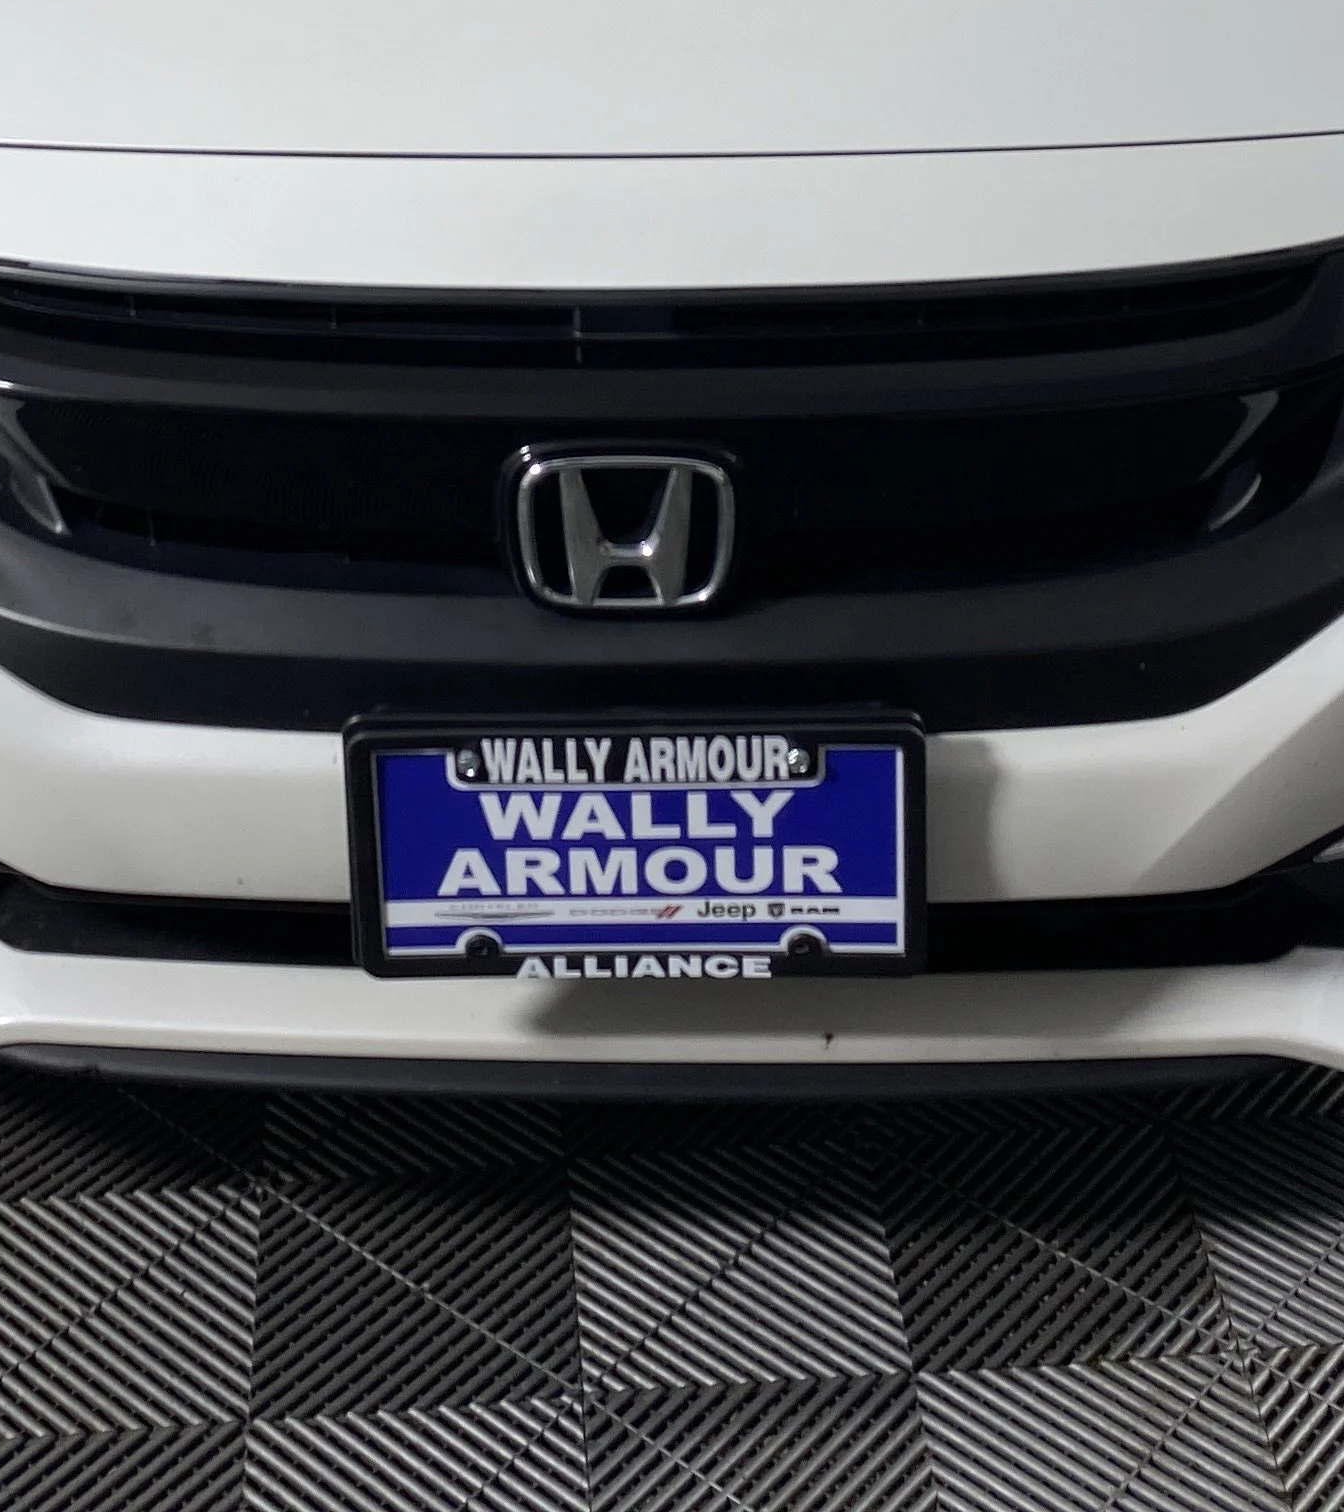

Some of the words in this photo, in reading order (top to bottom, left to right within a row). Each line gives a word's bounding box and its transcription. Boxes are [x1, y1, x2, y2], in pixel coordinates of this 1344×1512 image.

[480, 737, 612, 784] WALLY
[623, 735, 789, 783] ARMOUR
[478, 791, 795, 841] WALLY
[437, 845, 842, 896] ARMOUR
[697, 901, 757, 921] Jeep
[516, 956, 772, 980] ALLIANCE
